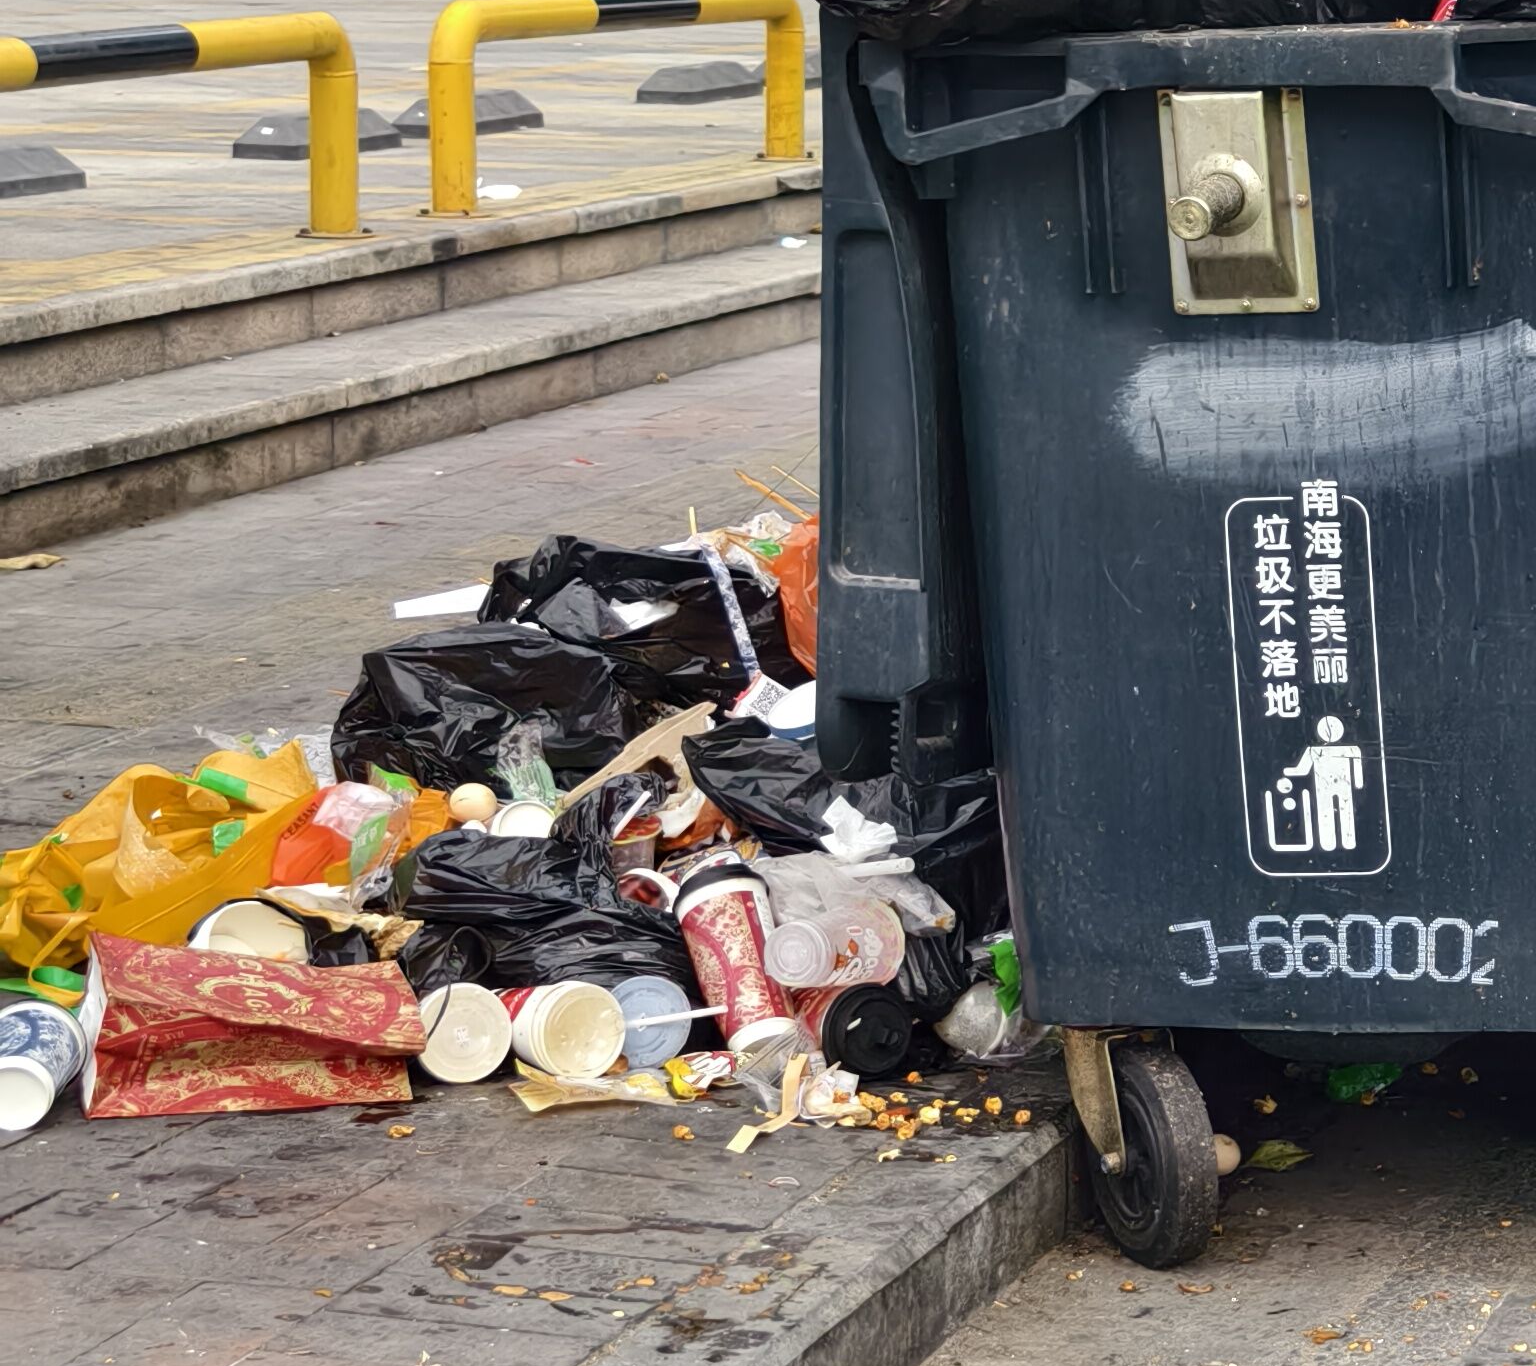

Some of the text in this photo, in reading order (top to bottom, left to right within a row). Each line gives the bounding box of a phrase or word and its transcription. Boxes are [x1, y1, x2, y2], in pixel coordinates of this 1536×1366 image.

[1253, 513, 1301, 718] 垃圾不落地
[1301, 478, 1349, 685] 南海更美丽
